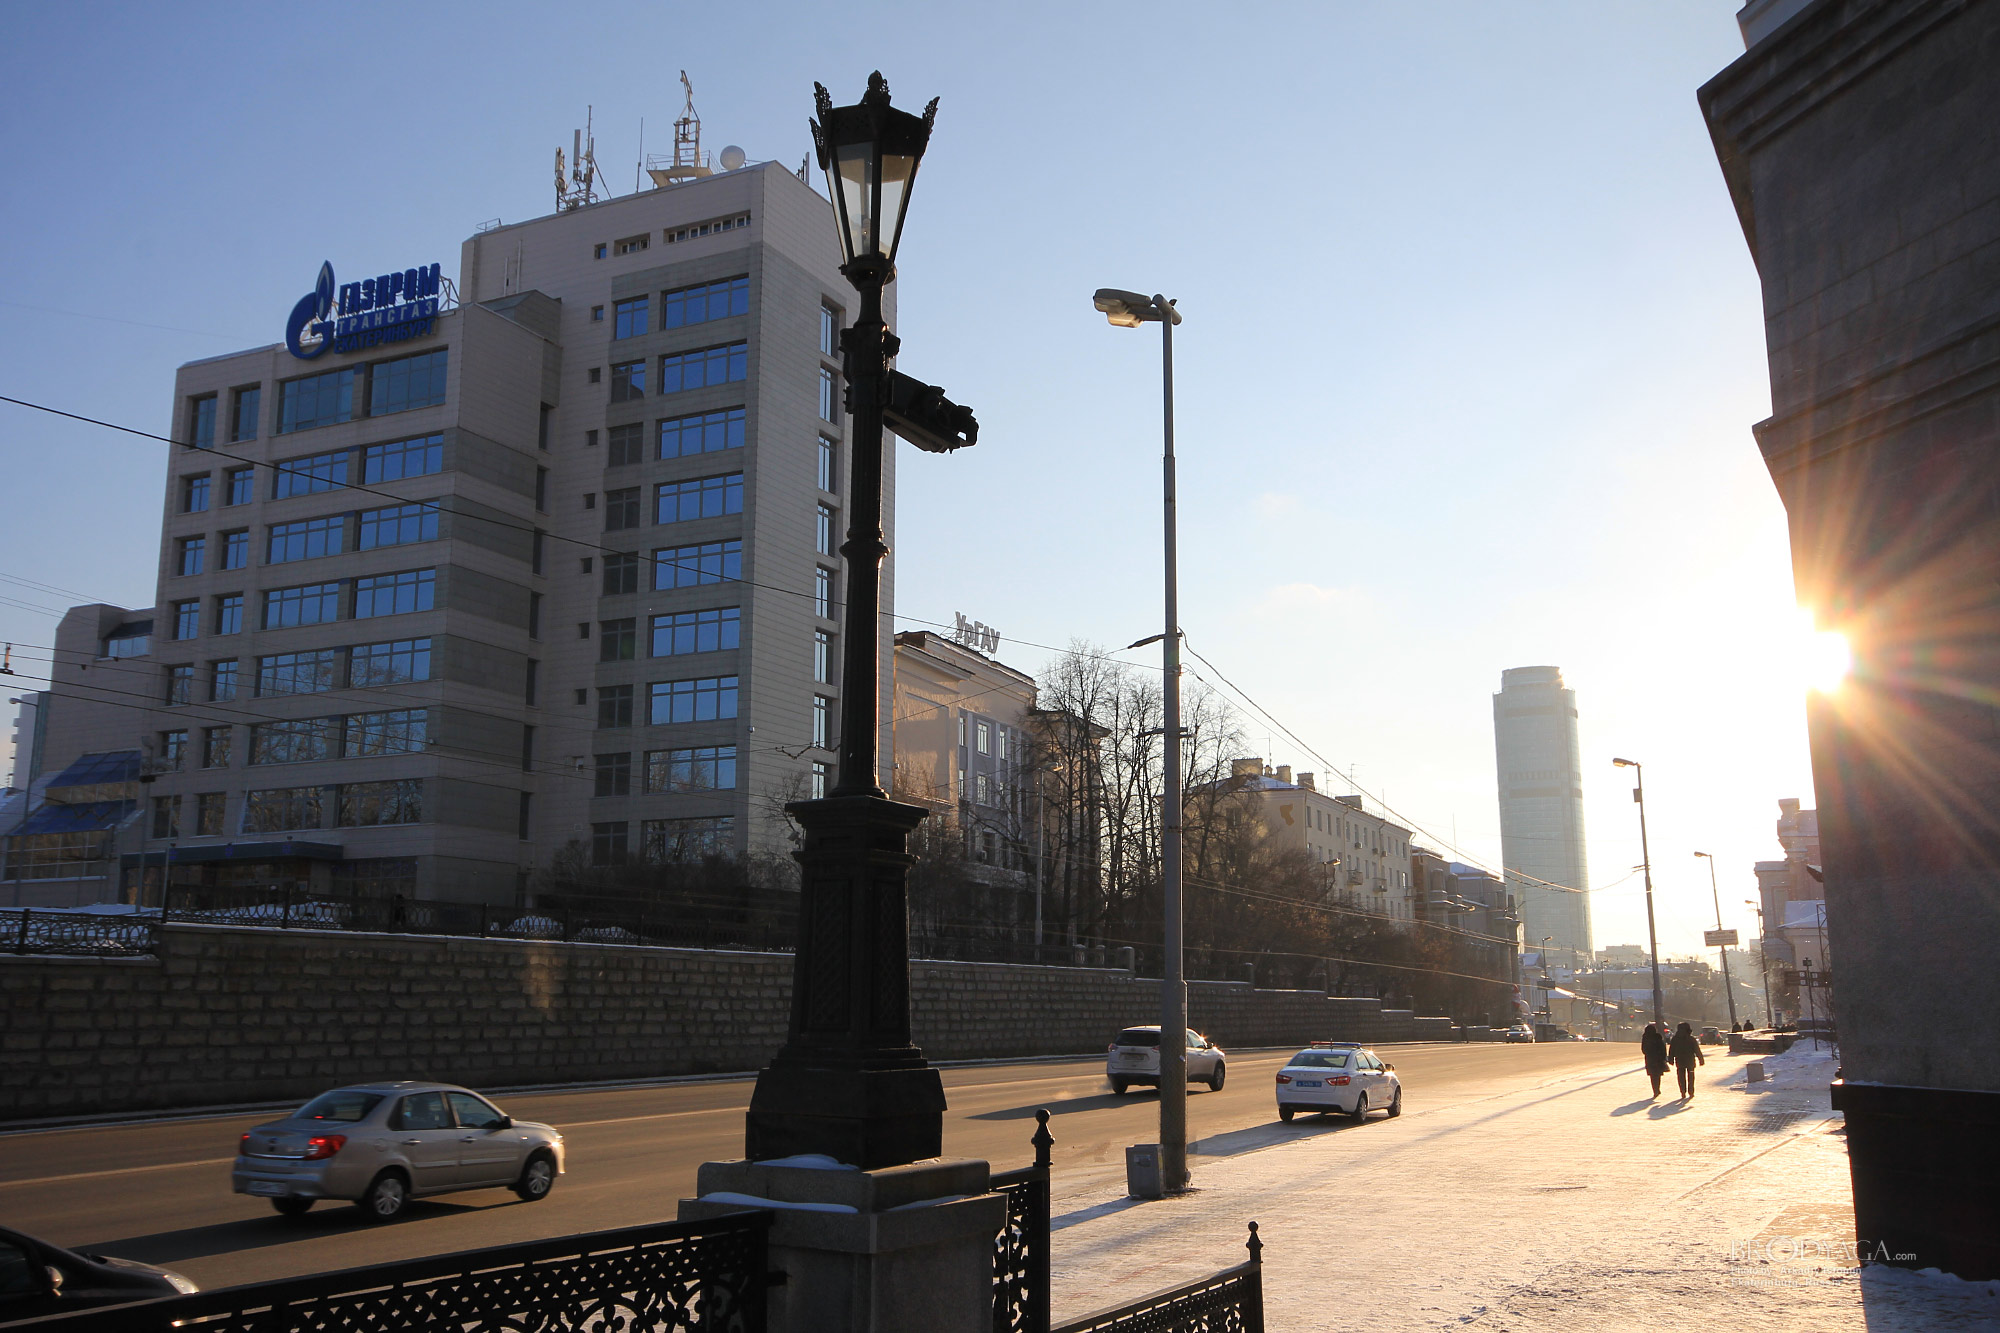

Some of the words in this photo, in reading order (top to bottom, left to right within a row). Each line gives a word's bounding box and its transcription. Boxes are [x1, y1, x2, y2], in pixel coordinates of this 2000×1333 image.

[338, 262, 441, 316] ГАЗПРОМ
[334, 317, 436, 355] ЕКАТЕРИНБУРГ
[338, 301, 434, 334] ТРАНСГАЗ
